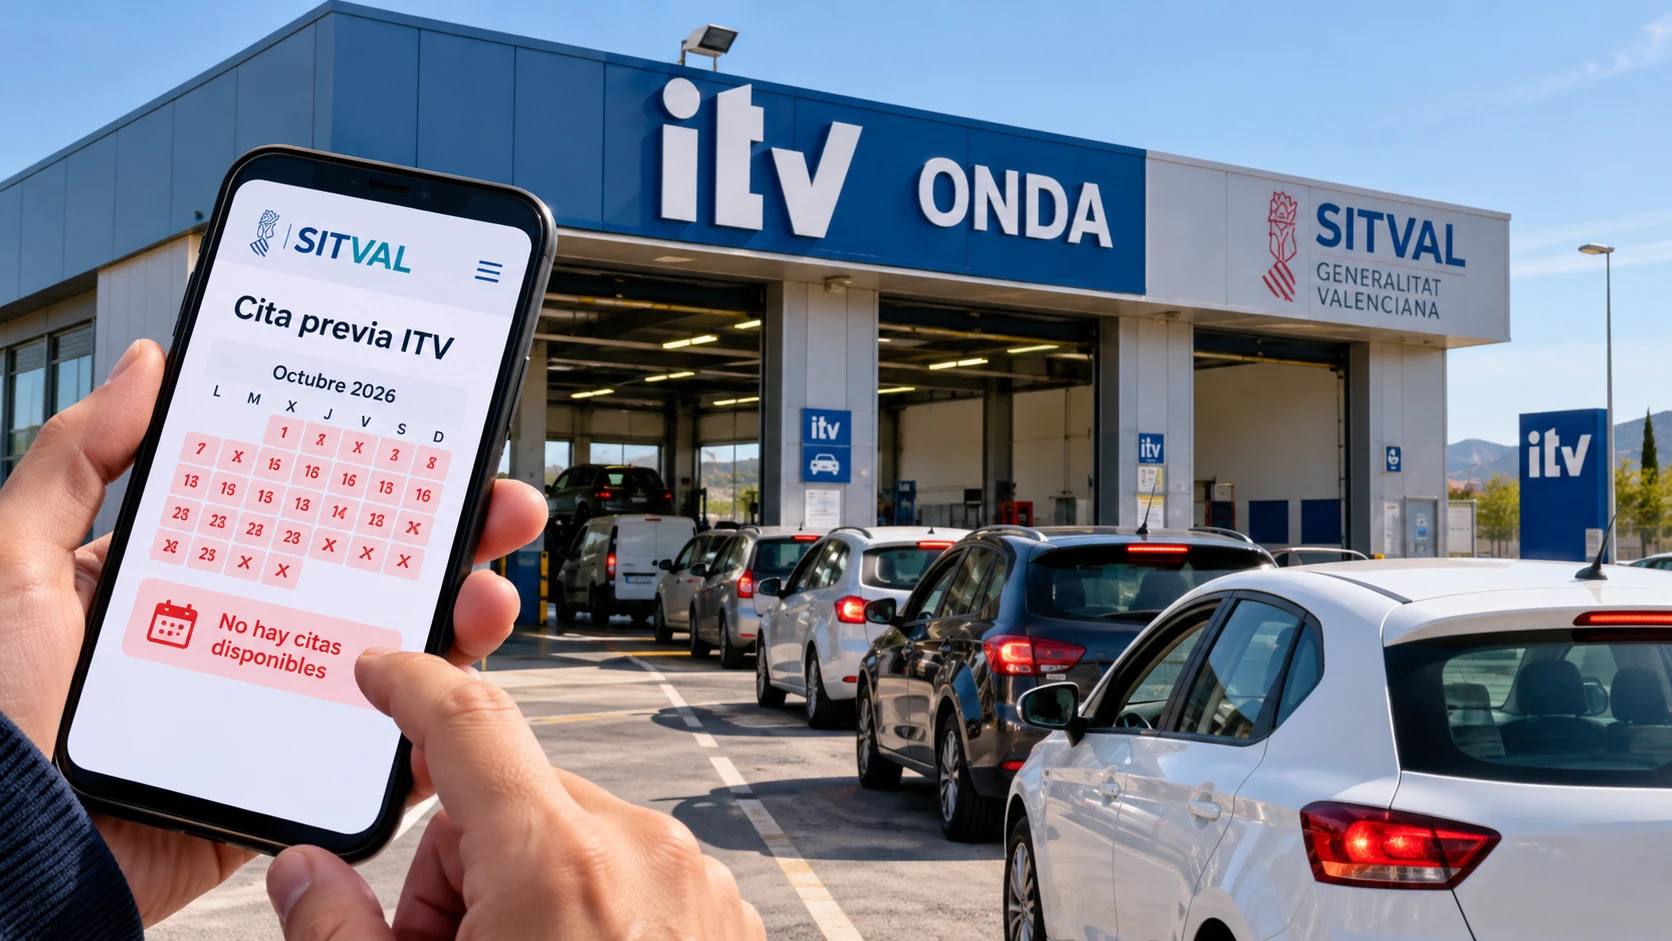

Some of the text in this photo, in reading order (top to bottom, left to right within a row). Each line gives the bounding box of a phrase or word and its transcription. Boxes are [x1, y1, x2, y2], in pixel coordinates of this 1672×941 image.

[661, 77, 1114, 249] itv ONDA
[293, 226, 412, 274] SITVAL
[1315, 202, 1467, 268] SITVAL
[1316, 261, 1442, 297] GENERALITAT
[1316, 286, 1441, 320] VALENCIANA
[234, 295, 455, 360] Cita previa ITV
[272, 364, 396, 404] Octubre 2026
[213, 384, 444, 443] L M X J V S D
[280, 426, 289, 439] 1
[811, 415, 841, 440] itv
[1140, 436, 1161, 459] itv
[1528, 427, 1592, 478] itv
[305, 464, 321, 480] 16
[341, 471, 357, 487] 16
[415, 487, 432, 503] 16
[218, 612, 342, 656] No hay citas
[210, 639, 327, 680] disponibles
